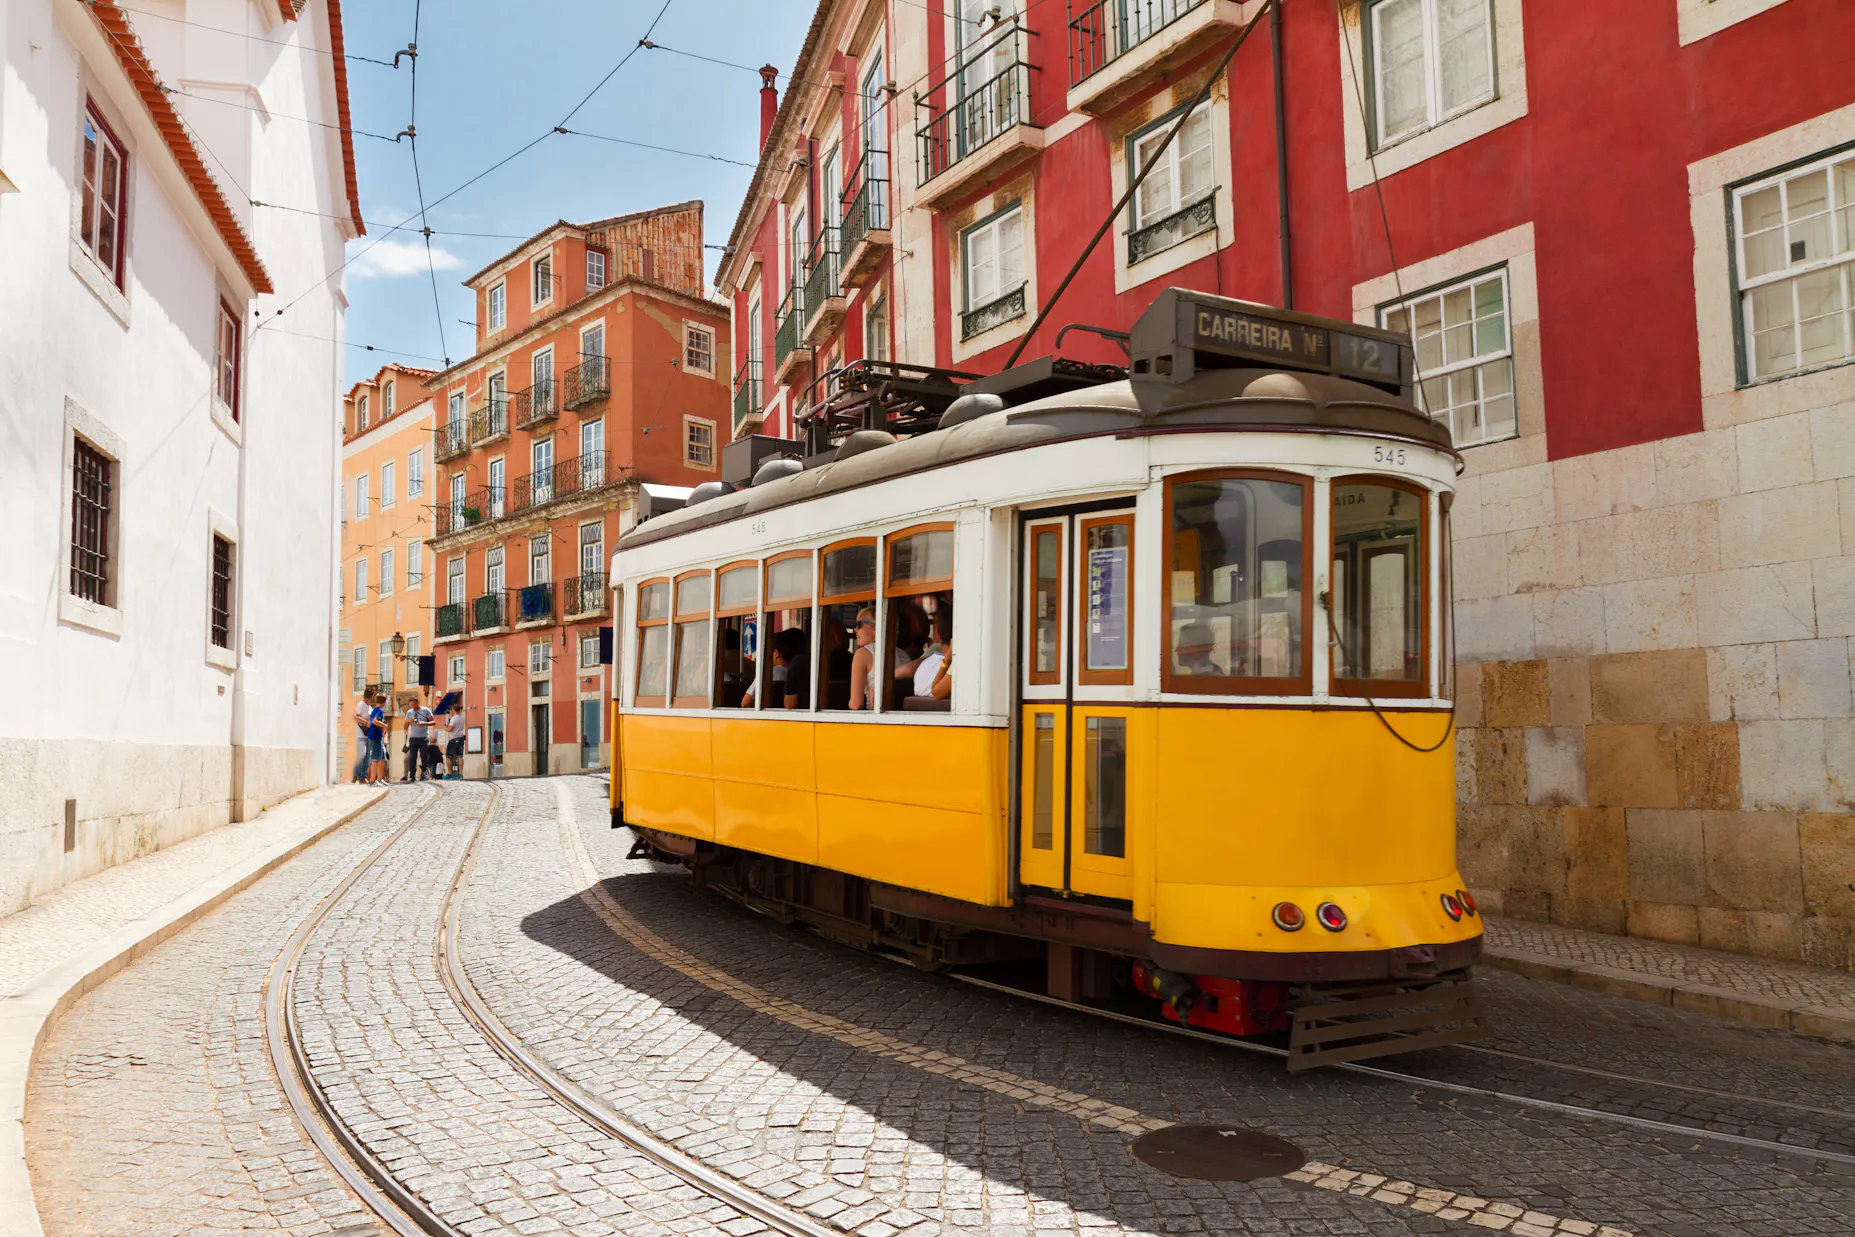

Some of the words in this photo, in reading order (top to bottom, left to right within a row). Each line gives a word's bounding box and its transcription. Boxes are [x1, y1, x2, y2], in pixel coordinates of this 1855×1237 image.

[1198, 311, 1293, 353] CARREIRA
[1351, 338, 1380, 371] 12
[1374, 445, 1406, 466] 545
[1333, 492, 1366, 507] AIDA
[752, 521, 766, 536] 545
